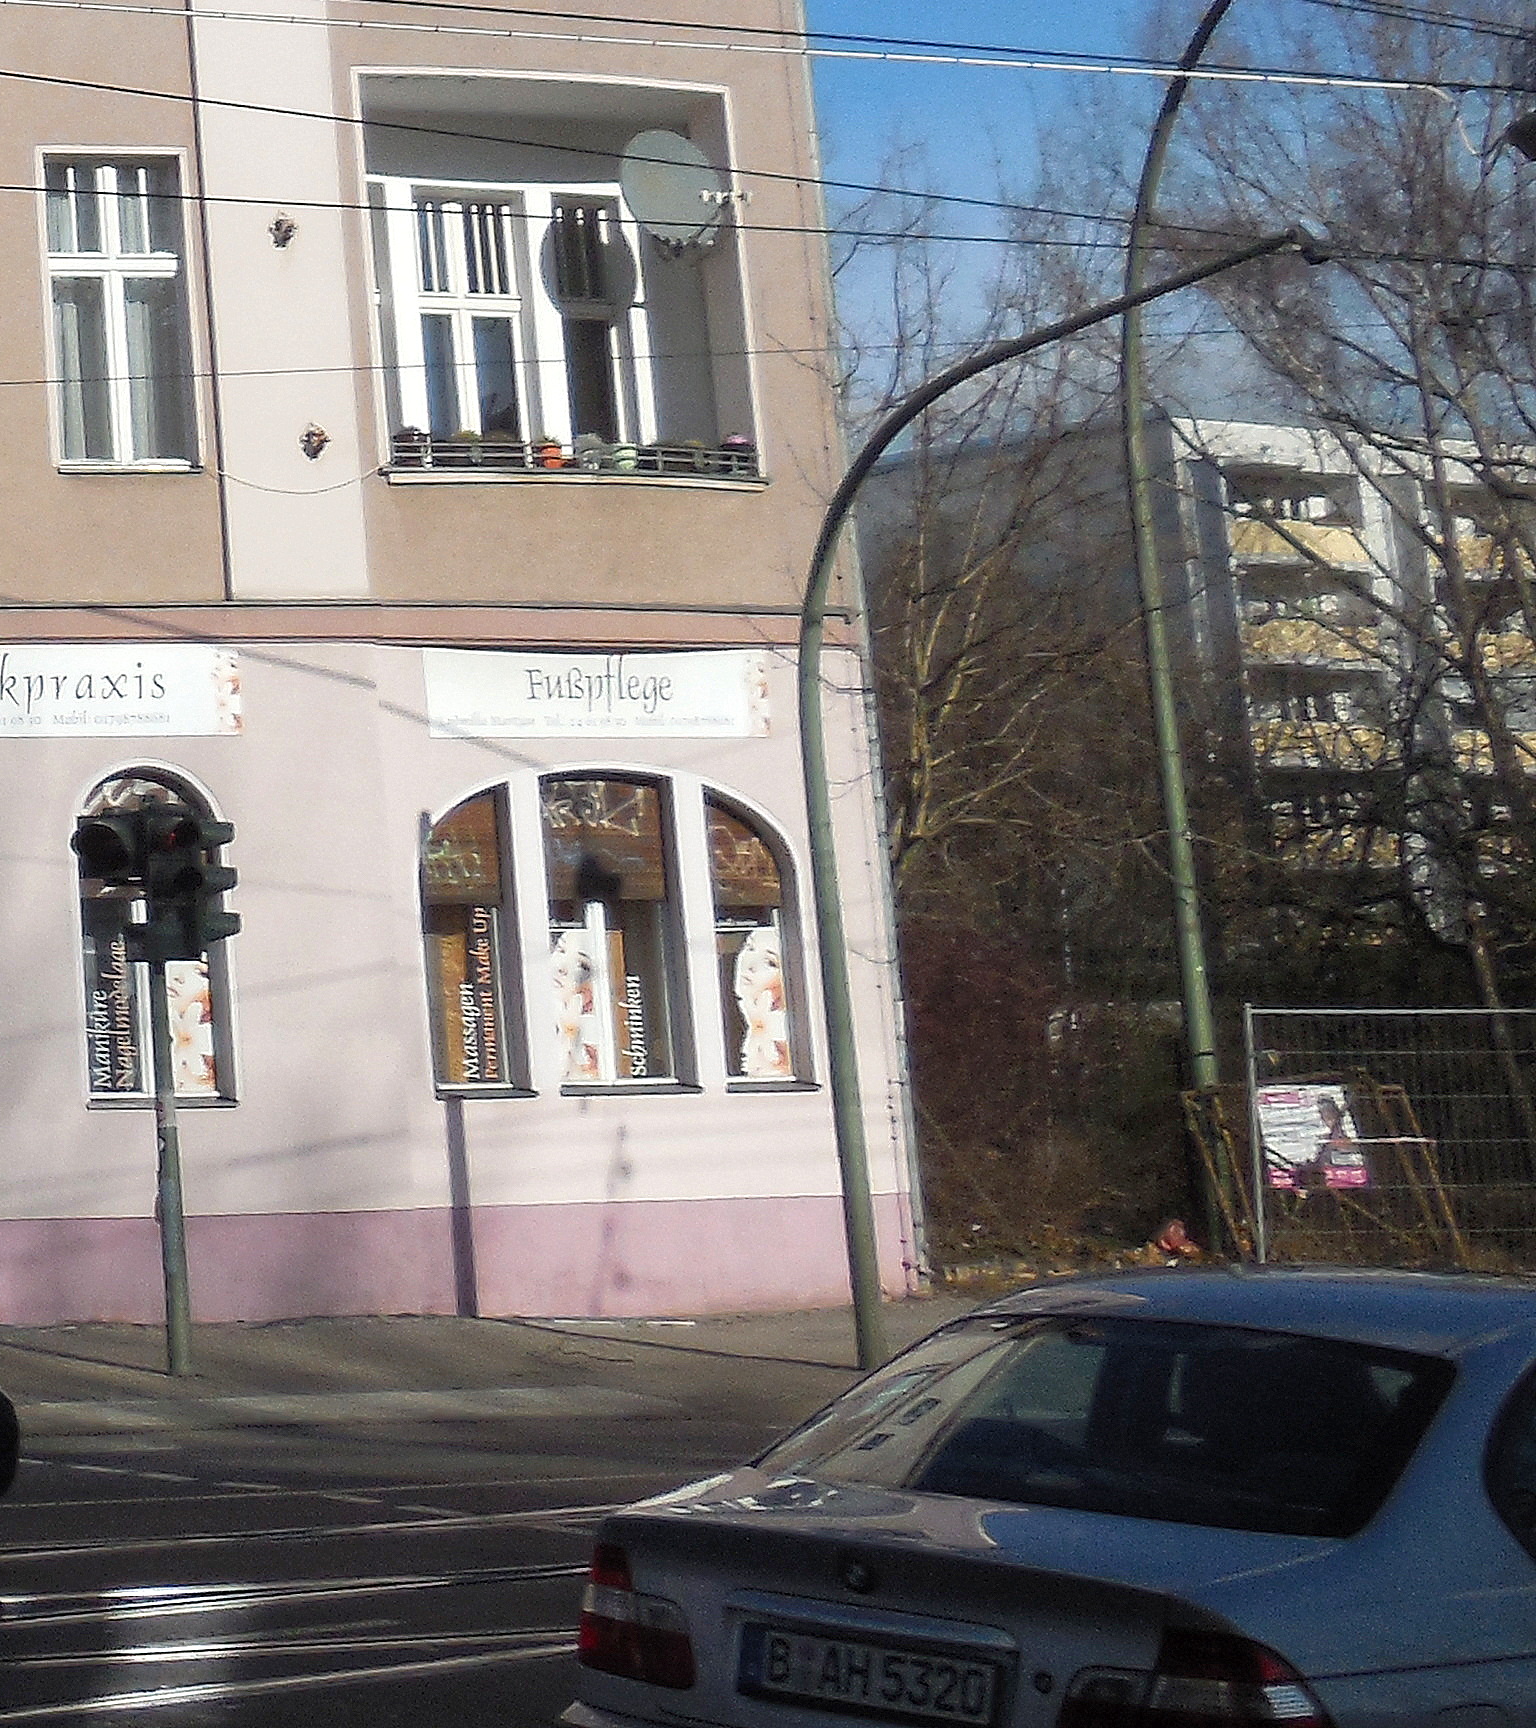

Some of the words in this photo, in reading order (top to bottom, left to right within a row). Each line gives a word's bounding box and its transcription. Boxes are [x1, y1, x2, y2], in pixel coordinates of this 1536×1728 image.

[524, 655, 674, 714] Fußpflege
[473, 906, 491, 934] Up
[468, 938, 492, 985] Make
[458, 982, 481, 1080] Massagen
[617, 974, 648, 1077] Schminken
[769, 1637, 792, 1682] B
